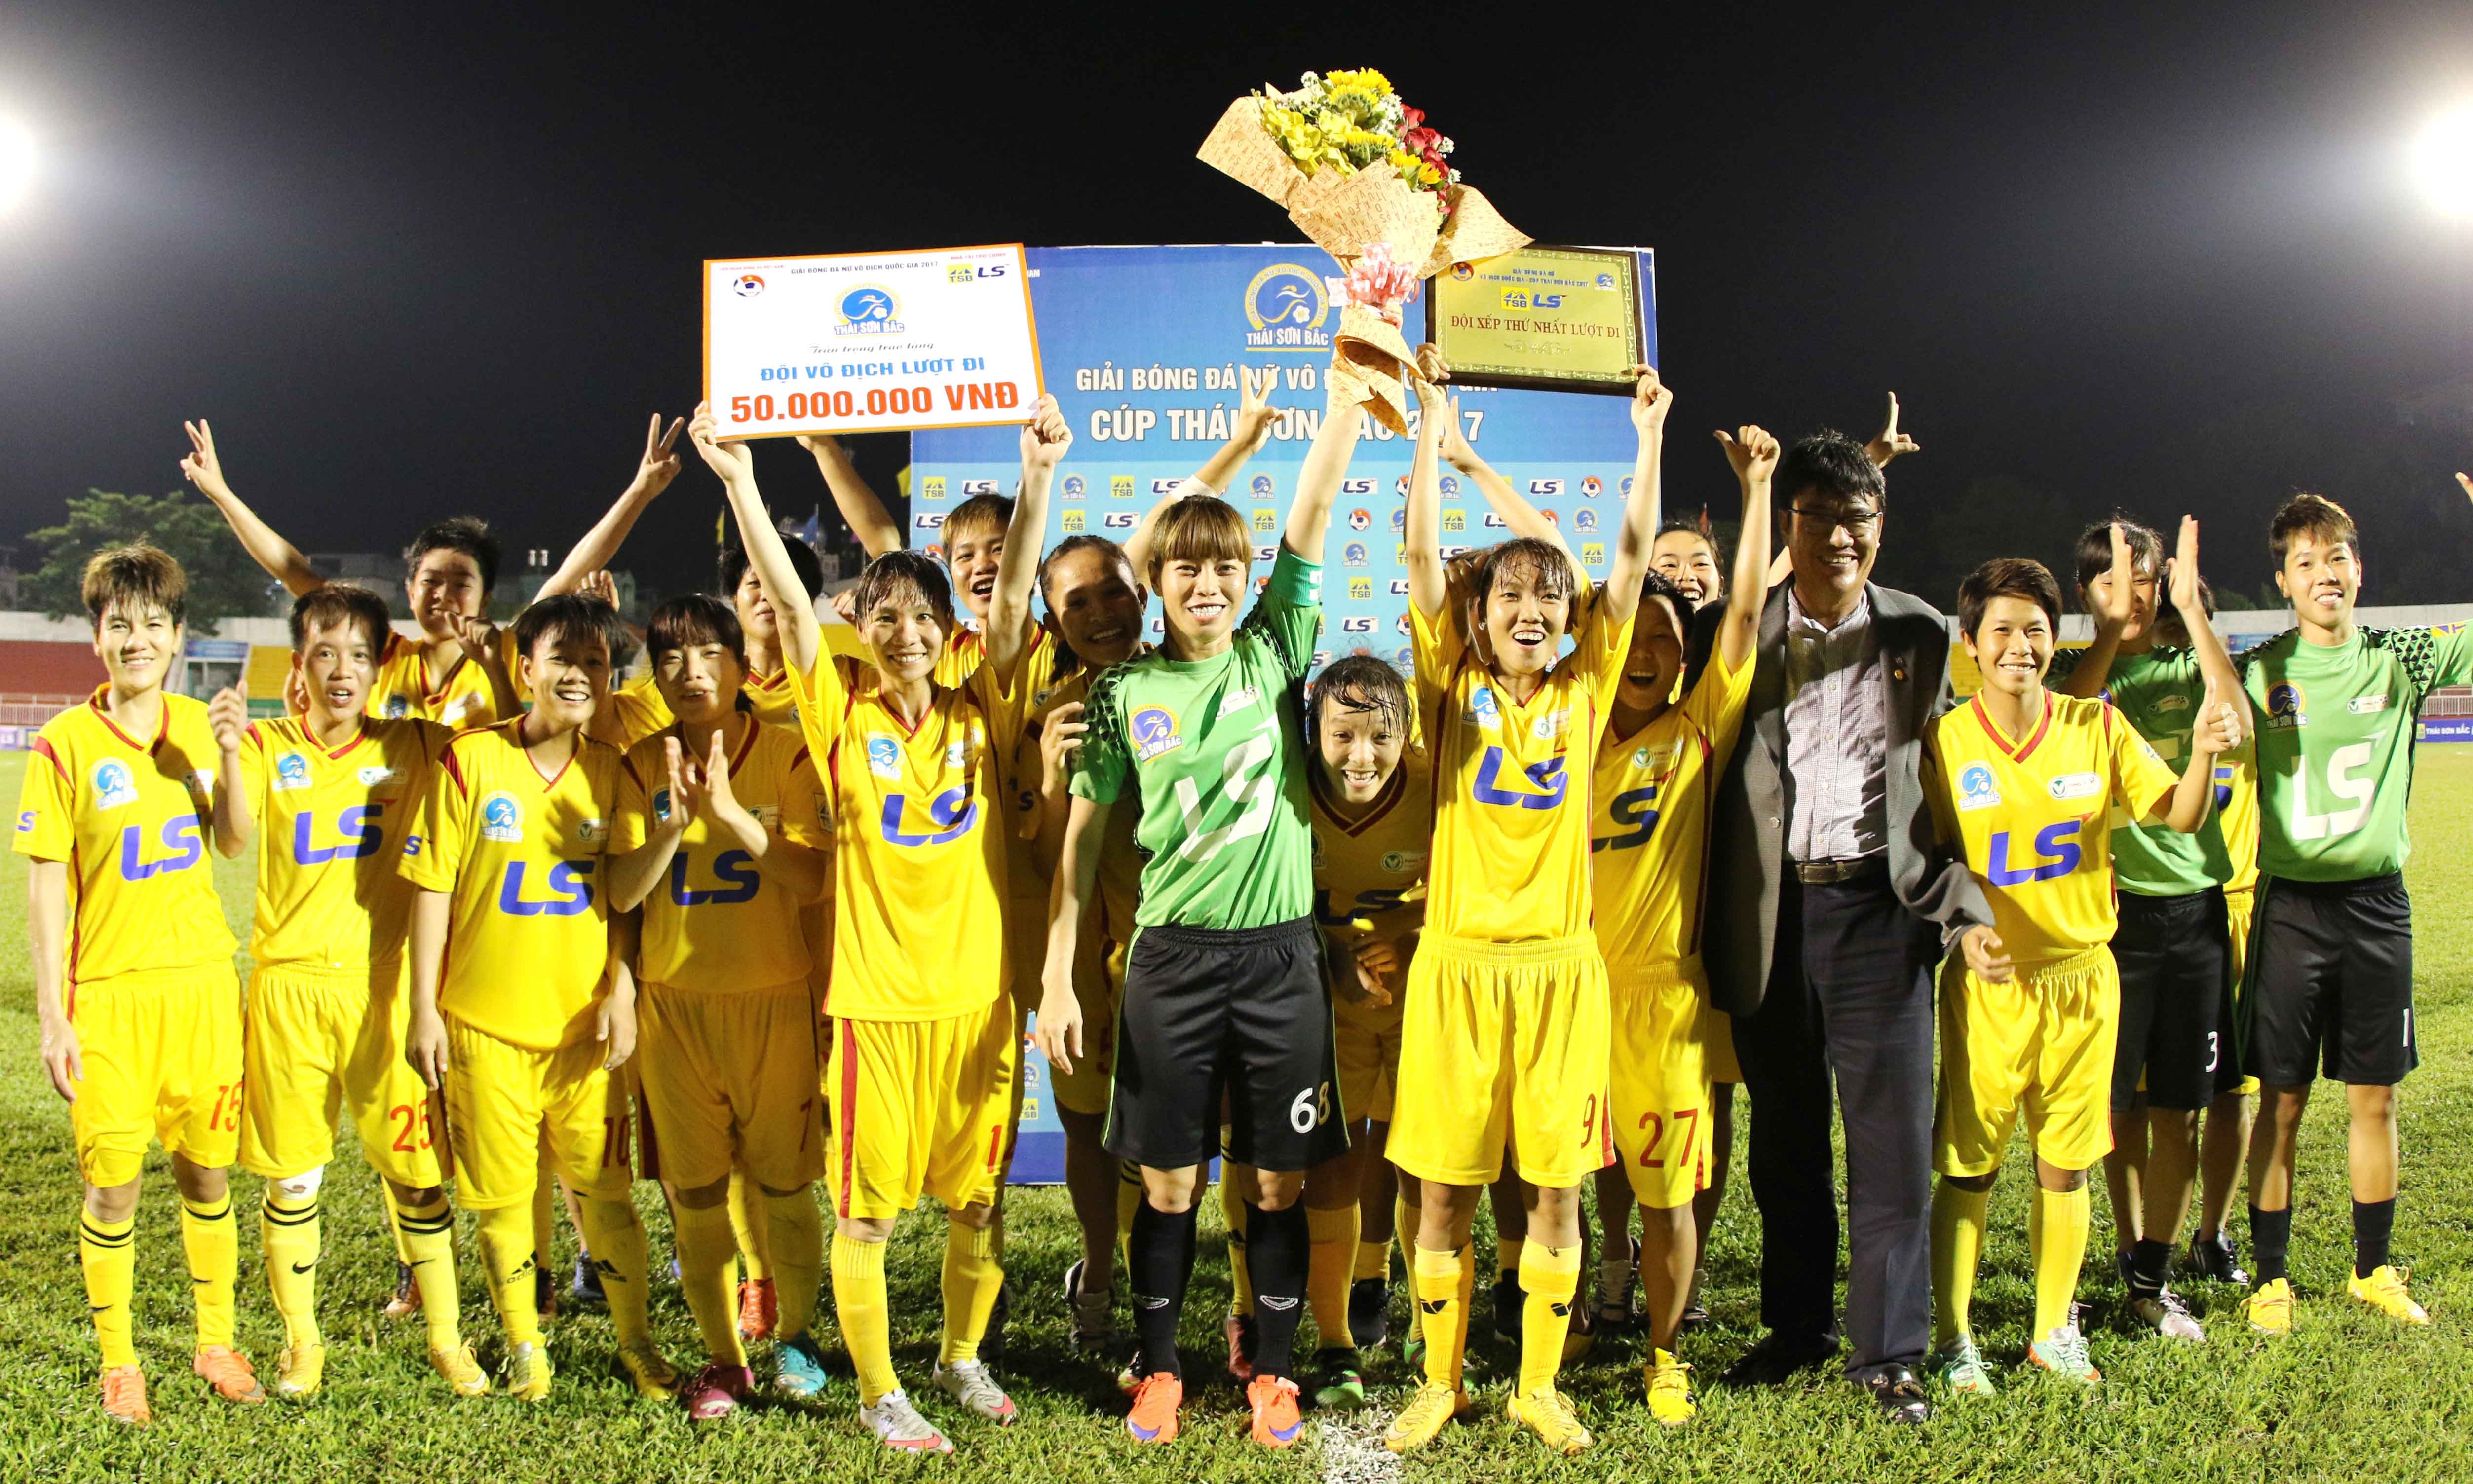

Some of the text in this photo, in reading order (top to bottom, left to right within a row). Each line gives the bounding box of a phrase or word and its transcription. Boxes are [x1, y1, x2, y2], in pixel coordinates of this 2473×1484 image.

[978, 265, 1005, 278] LS
[1503, 299, 1528, 308] TSB
[1532, 293, 1562, 308] LS
[1246, 326, 1329, 346] THÁI SƠN BẮC
[1451, 312, 1620, 339] ĐỘI XẾP THỨ NHẤT LƯỢT ĐI
[760, 357, 986, 384] ĐỘI VÔ ĐỊCH LƯỢT ĐI
[1076, 361, 1124, 391] GIẢI
[1131, 363, 1198, 391] BÓNG
[1204, 363, 1238, 390] ĐÁ
[1285, 363, 1317, 391] VÔ
[731, 381, 1020, 423] 50.000.000 VNĐ
[1090, 403, 1157, 442] CÚP
[1166, 403, 1240, 442] THÁI
[1267, 406, 1320, 441] ƠN
[1406, 410, 1484, 441] 27
[924, 489, 945, 498] TSB
[963, 482, 990, 495] LS
[1342, 481, 1370, 493] LS
[1530, 481, 1557, 494] LS
[916, 516, 943, 528] LS
[1105, 515, 1133, 528] LS
[1343, 619, 1371, 632] LS
[1175, 731, 1276, 863] LS
[1473, 745, 1569, 810] LS
[2291, 742, 2375, 840] LS
[16, 811, 37, 832] S
[881, 783, 978, 847] LS
[120, 814, 202, 882] LS
[294, 804, 383, 866] LS
[403, 835, 422, 856] S
[1987, 820, 2081, 888] LS
[499, 860, 595, 916] LS
[671, 849, 760, 906] LS
[2402, 1008, 2410, 1047] 1
[2205, 1030, 2218, 1073] 3
[210, 1081, 243, 1132] 15
[389, 1098, 435, 1153] 25
[1290, 1081, 1331, 1134] 68
[1581, 1093, 1596, 1149] 9
[603, 1115, 630, 1168] 10
[1639, 1108, 1698, 1168] 27
